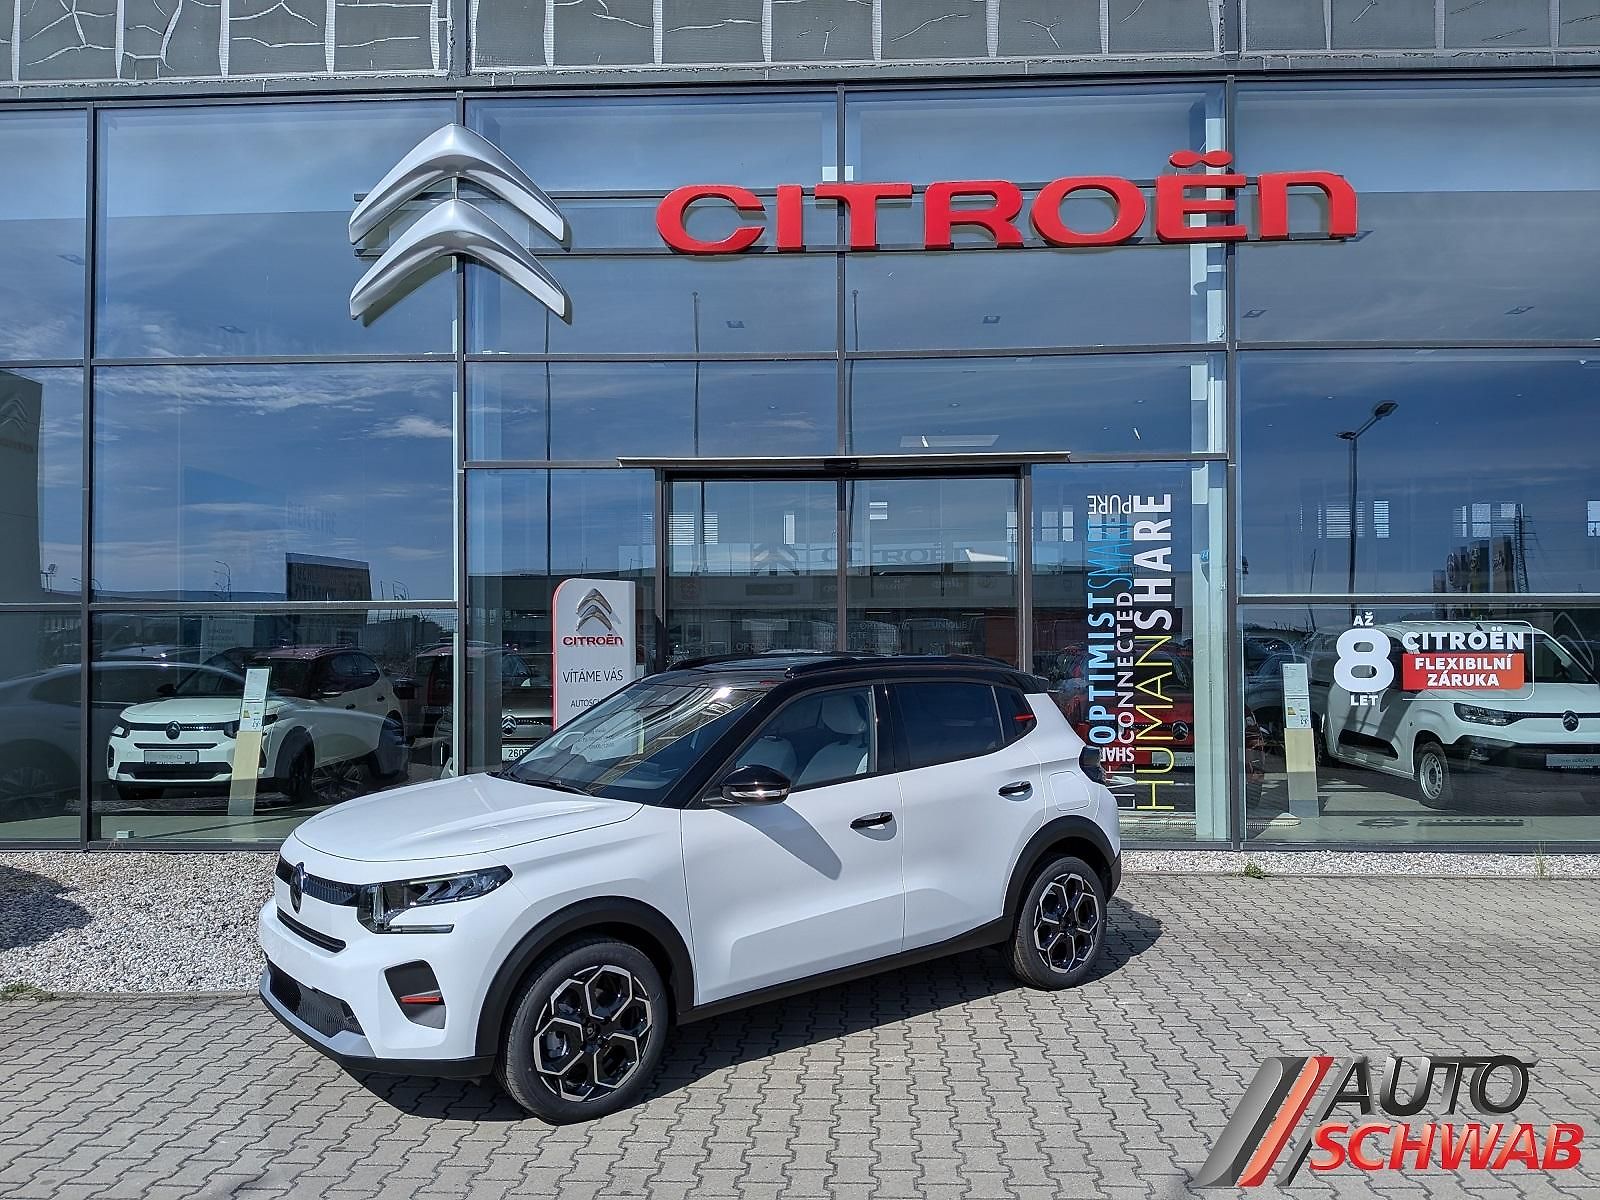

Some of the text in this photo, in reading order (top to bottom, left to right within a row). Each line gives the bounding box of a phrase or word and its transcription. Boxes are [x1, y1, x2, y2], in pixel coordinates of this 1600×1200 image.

[656, 149, 1358, 254] CITROËN
[1087, 494, 1132, 515] PURE
[1088, 519, 1133, 590] SMART
[1133, 493, 1172, 632] SHARE
[1353, 612, 1374, 626] AŽ
[563, 634, 624, 646] CITROËN
[1402, 626, 1525, 651] CITROËN
[1088, 592, 1116, 745] OPTIMIST
[1116, 592, 1135, 744] CONNECTED
[1333, 628, 1395, 693] 8
[1415, 654, 1513, 670] FLEXIBILNÍ
[562, 667, 624, 683] VÍTÁME VÁS
[1427, 670, 1500, 687] ZÁRUKA
[1350, 694, 1379, 706] LET
[1134, 635, 1175, 810] HUMAN
